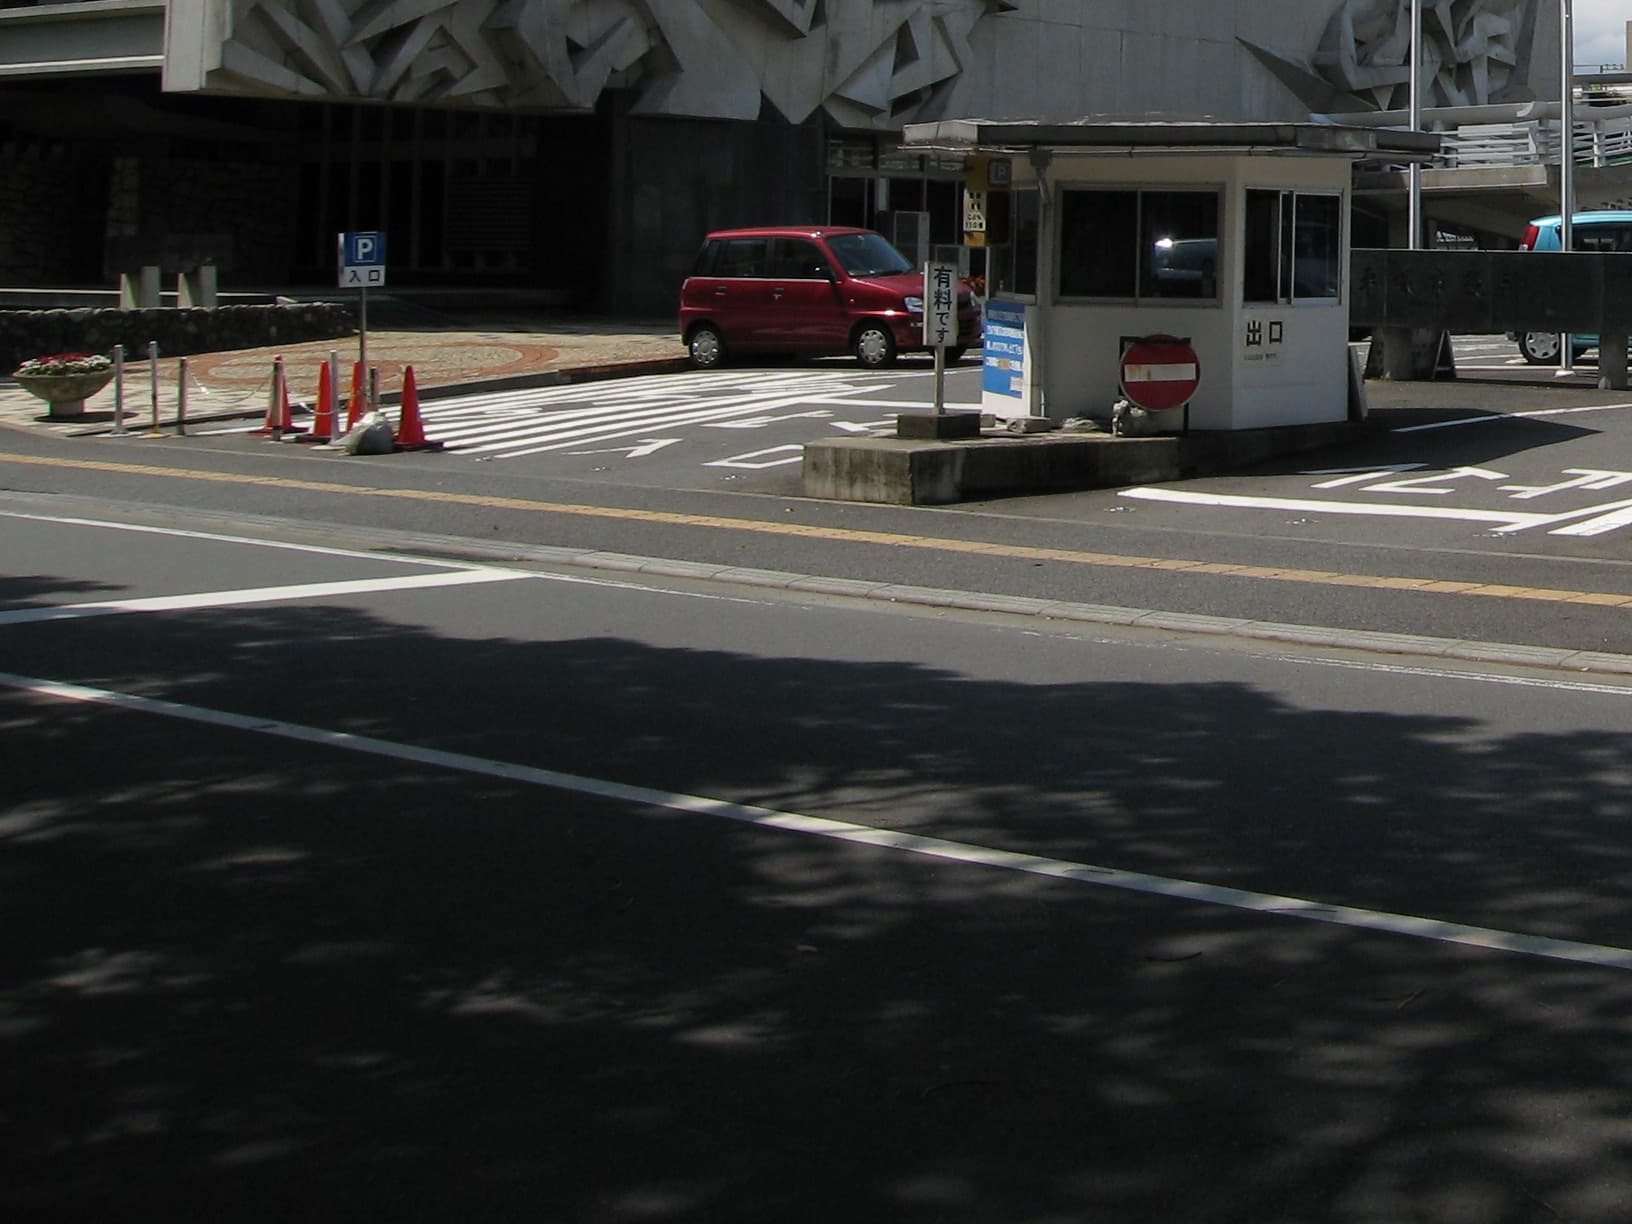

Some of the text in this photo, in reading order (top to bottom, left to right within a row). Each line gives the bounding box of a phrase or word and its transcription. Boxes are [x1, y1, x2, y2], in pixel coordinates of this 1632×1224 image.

[357, 238, 373, 260] P
[349, 270, 380, 283] 入口
[934, 266, 952, 343] 有料です
[1246, 320, 1283, 346] 出口
